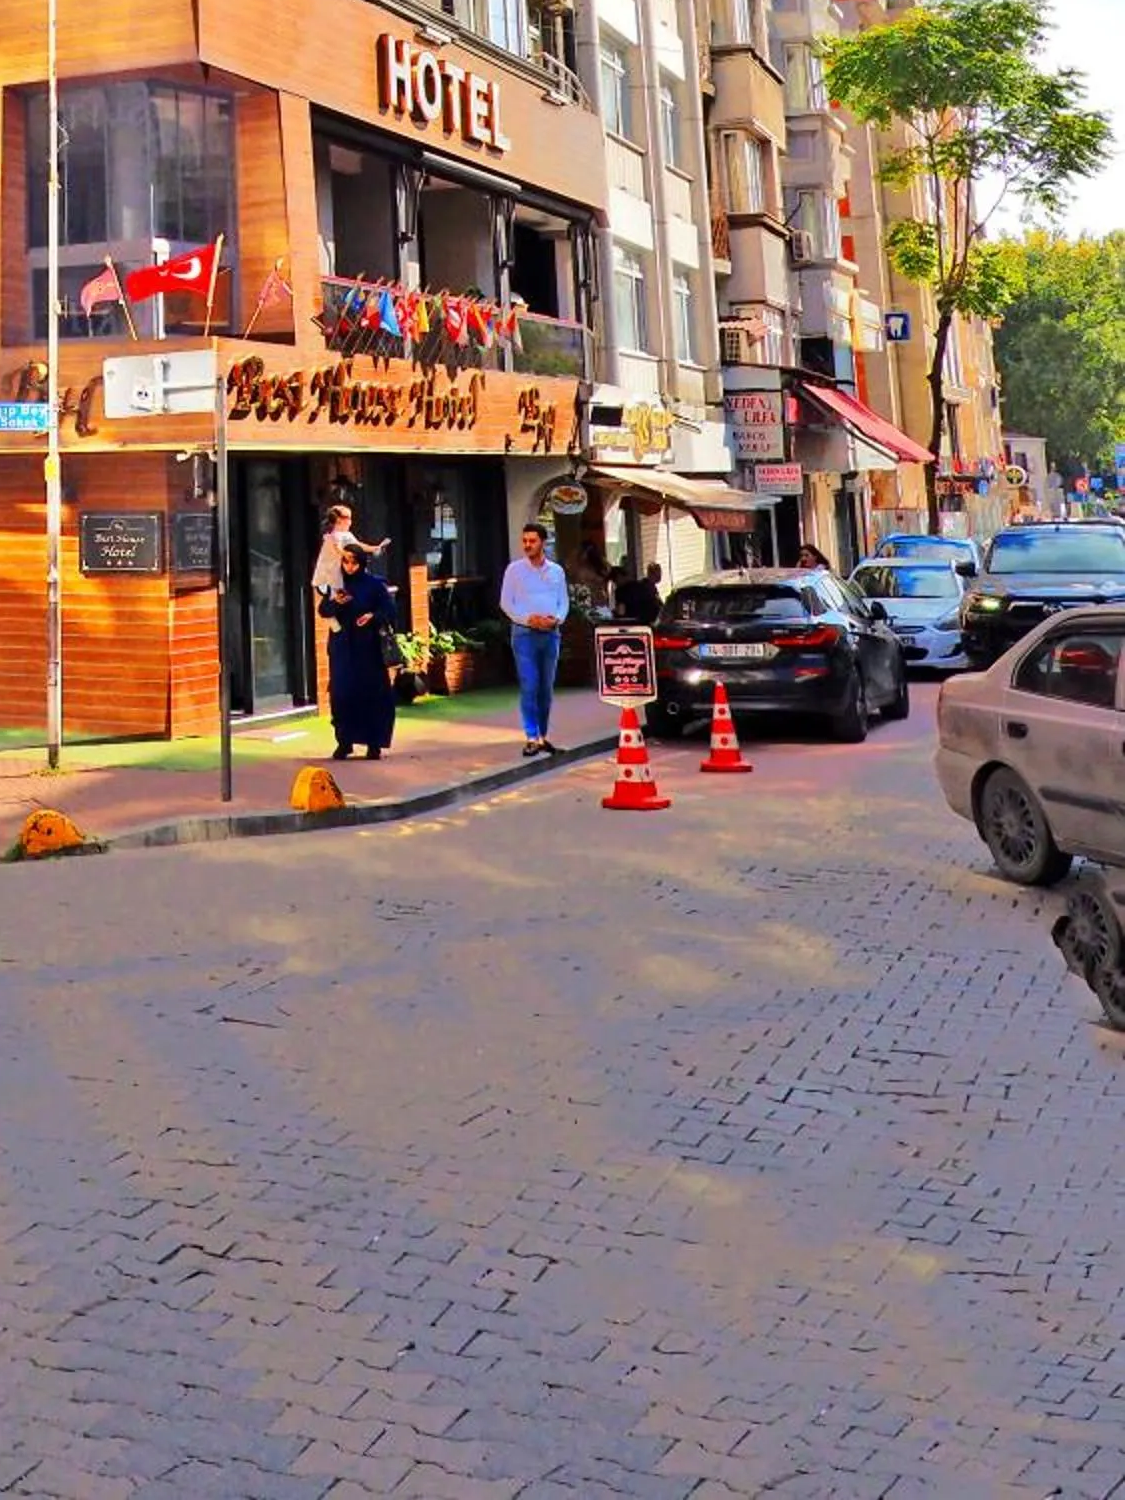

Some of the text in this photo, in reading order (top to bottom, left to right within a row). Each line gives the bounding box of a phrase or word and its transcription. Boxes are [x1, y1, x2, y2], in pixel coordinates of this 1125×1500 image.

[377, 33, 511, 153] HOTEL
[226, 355, 486, 431] Best House Hotel
[99, 544, 138, 558] Hotel
